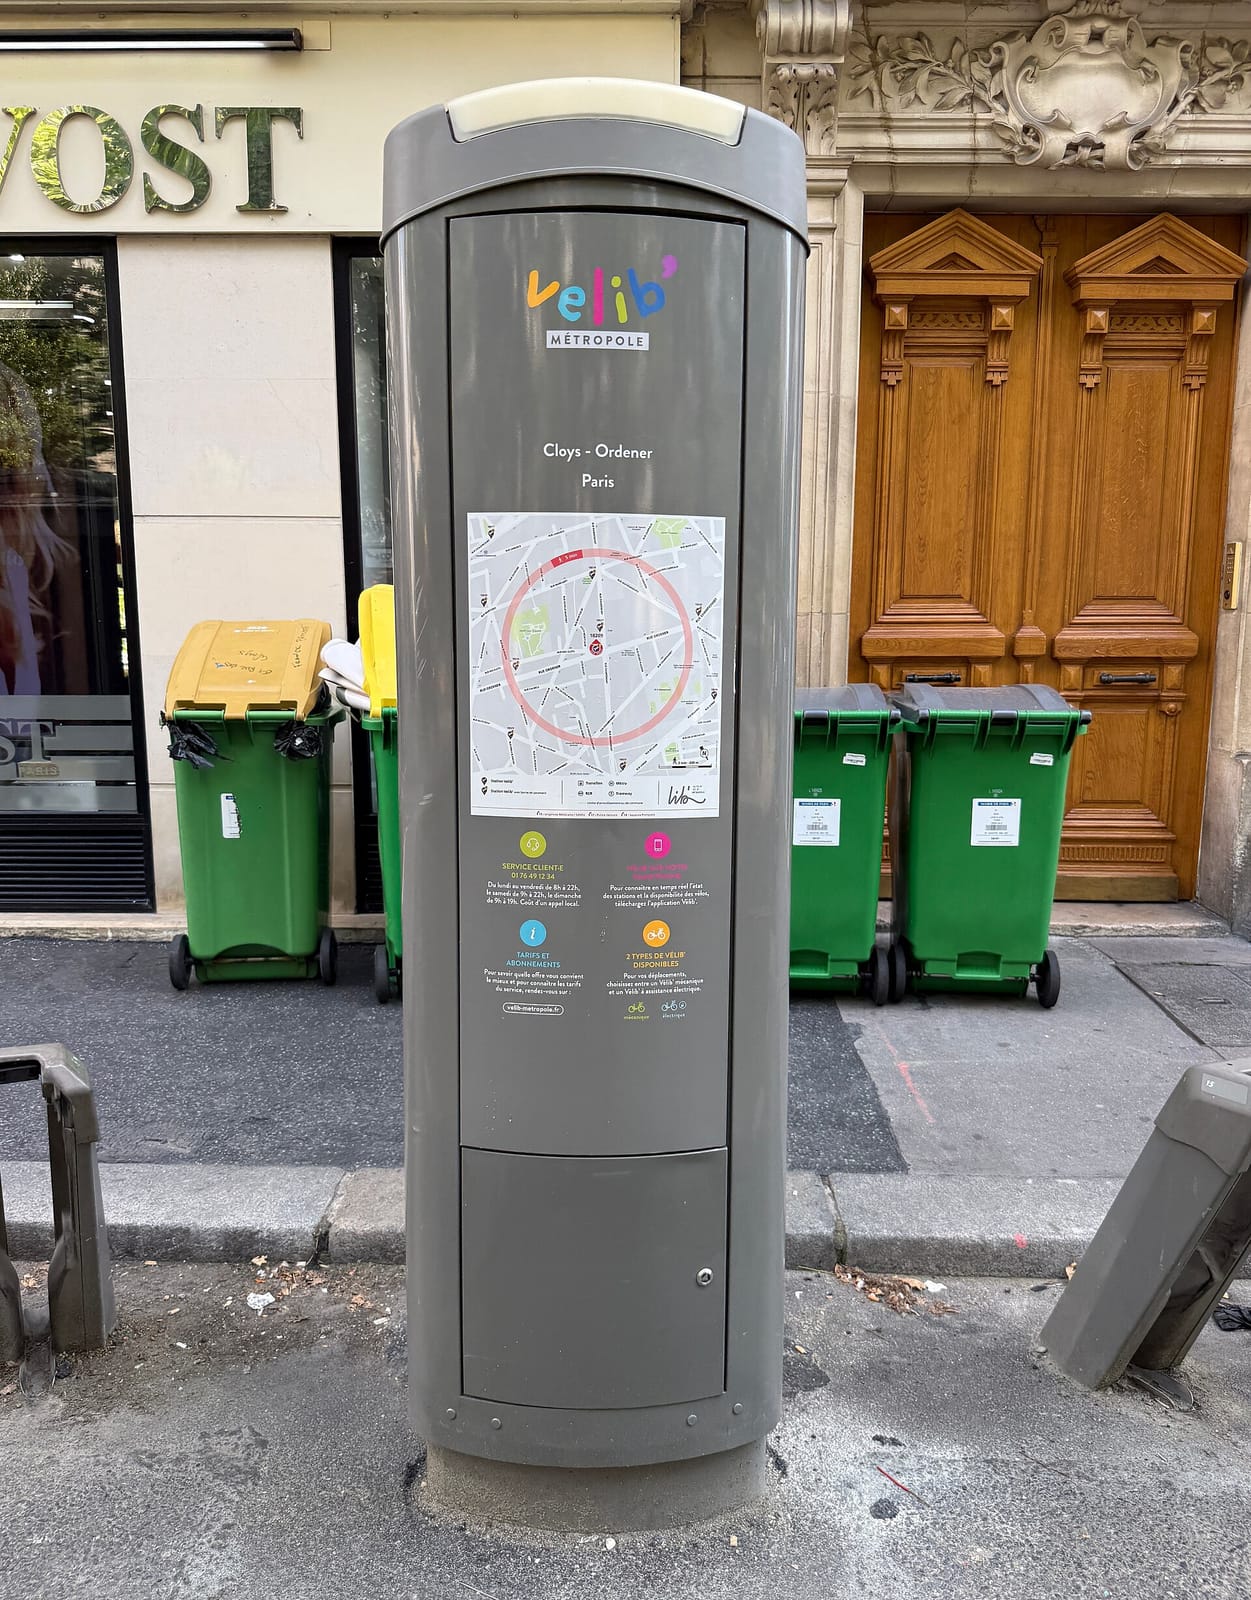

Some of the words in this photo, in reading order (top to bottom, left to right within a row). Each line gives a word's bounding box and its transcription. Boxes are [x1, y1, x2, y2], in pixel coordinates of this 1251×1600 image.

[550, 332, 644, 347] MÉTROPOLE
[544, 443, 581, 462] Cloys
[595, 443, 653, 459] Ordener
[582, 473, 614, 488] Paris
[650, 891, 683, 900] disponibilité
[615, 900, 646, 908] téléchargez
[647, 899, 680, 908] l'application
[506, 960, 560, 968] ABONNEMENTS
[633, 960, 679, 969] DISPONIBLES
[514, 971, 530, 979] quelle
[674, 986, 701, 994] électrique.
[1206, 1079, 1215, 1088] 15
